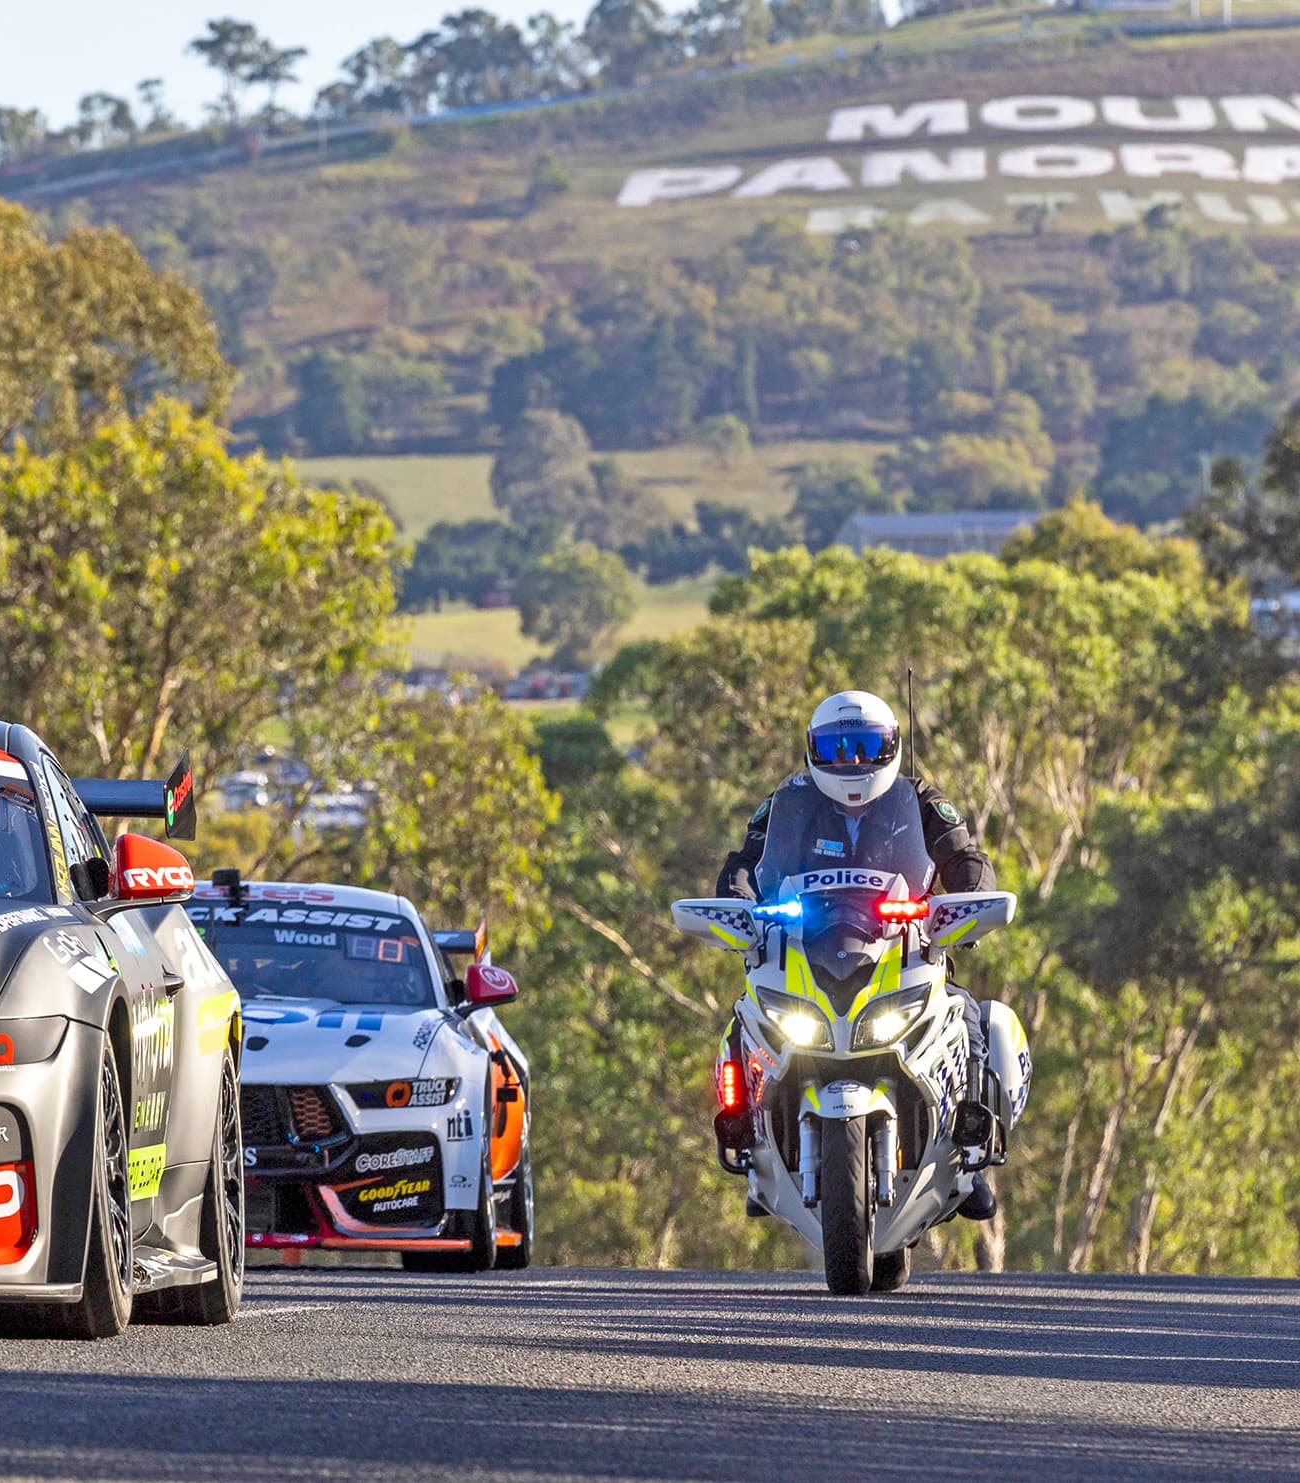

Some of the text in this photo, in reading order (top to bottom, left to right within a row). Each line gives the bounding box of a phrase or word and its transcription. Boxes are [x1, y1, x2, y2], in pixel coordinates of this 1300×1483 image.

[124, 866, 194, 889] RYCO
[803, 871, 884, 889] Police
[245, 907, 402, 931] ASSIST
[274, 929, 337, 946] Wood
[411, 1079, 447, 1092] TRUCK
[408, 1092, 445, 1106] ASSIST
[359, 1179, 431, 1201] GOODYEAR
[373, 1196, 419, 1213] AUTOCARE
